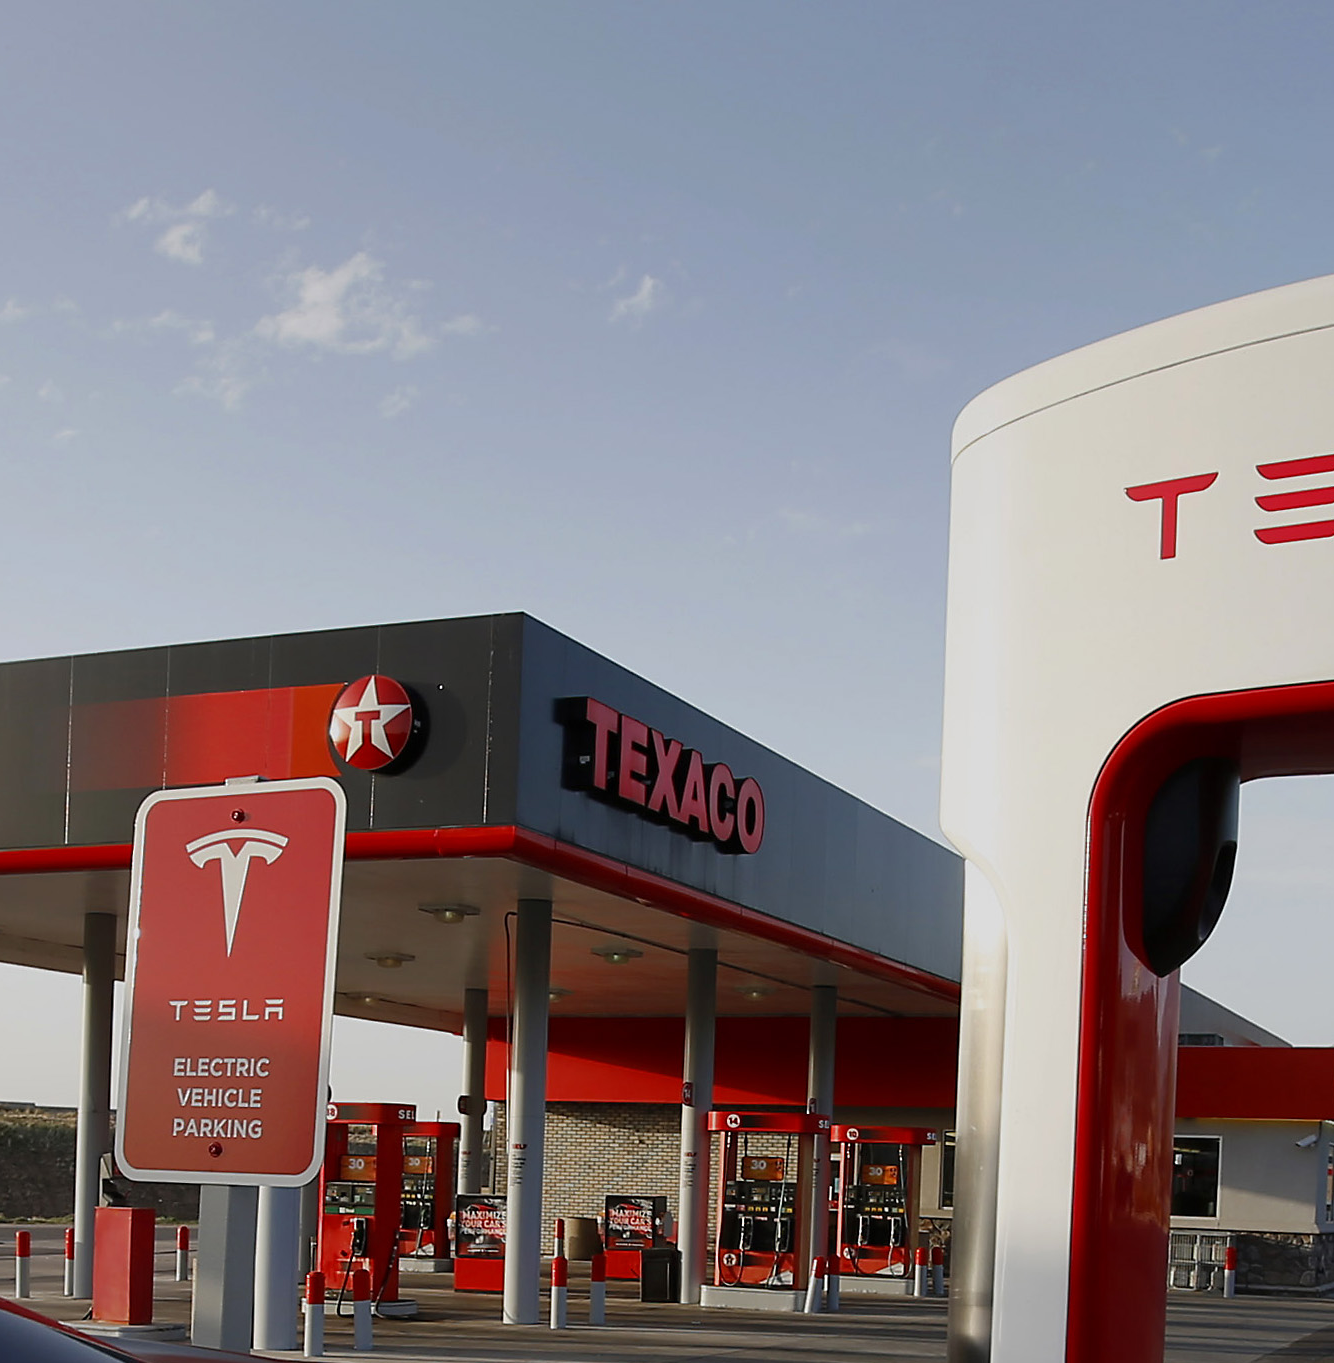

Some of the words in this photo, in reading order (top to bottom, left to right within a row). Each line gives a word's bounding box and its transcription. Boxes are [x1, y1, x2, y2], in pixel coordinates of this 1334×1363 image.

[586, 697, 765, 854] TEXACO
[168, 998, 285, 1021] TESLA
[173, 1057, 271, 1078] ELECTRIC
[176, 1087, 263, 1109] VEHICLE
[172, 1117, 263, 1140] PARKING
[348, 1158, 365, 1170] 30
[408, 1157, 421, 1166] 30
[750, 1159, 767, 1170] 30
[869, 1166, 884, 1176] 30
